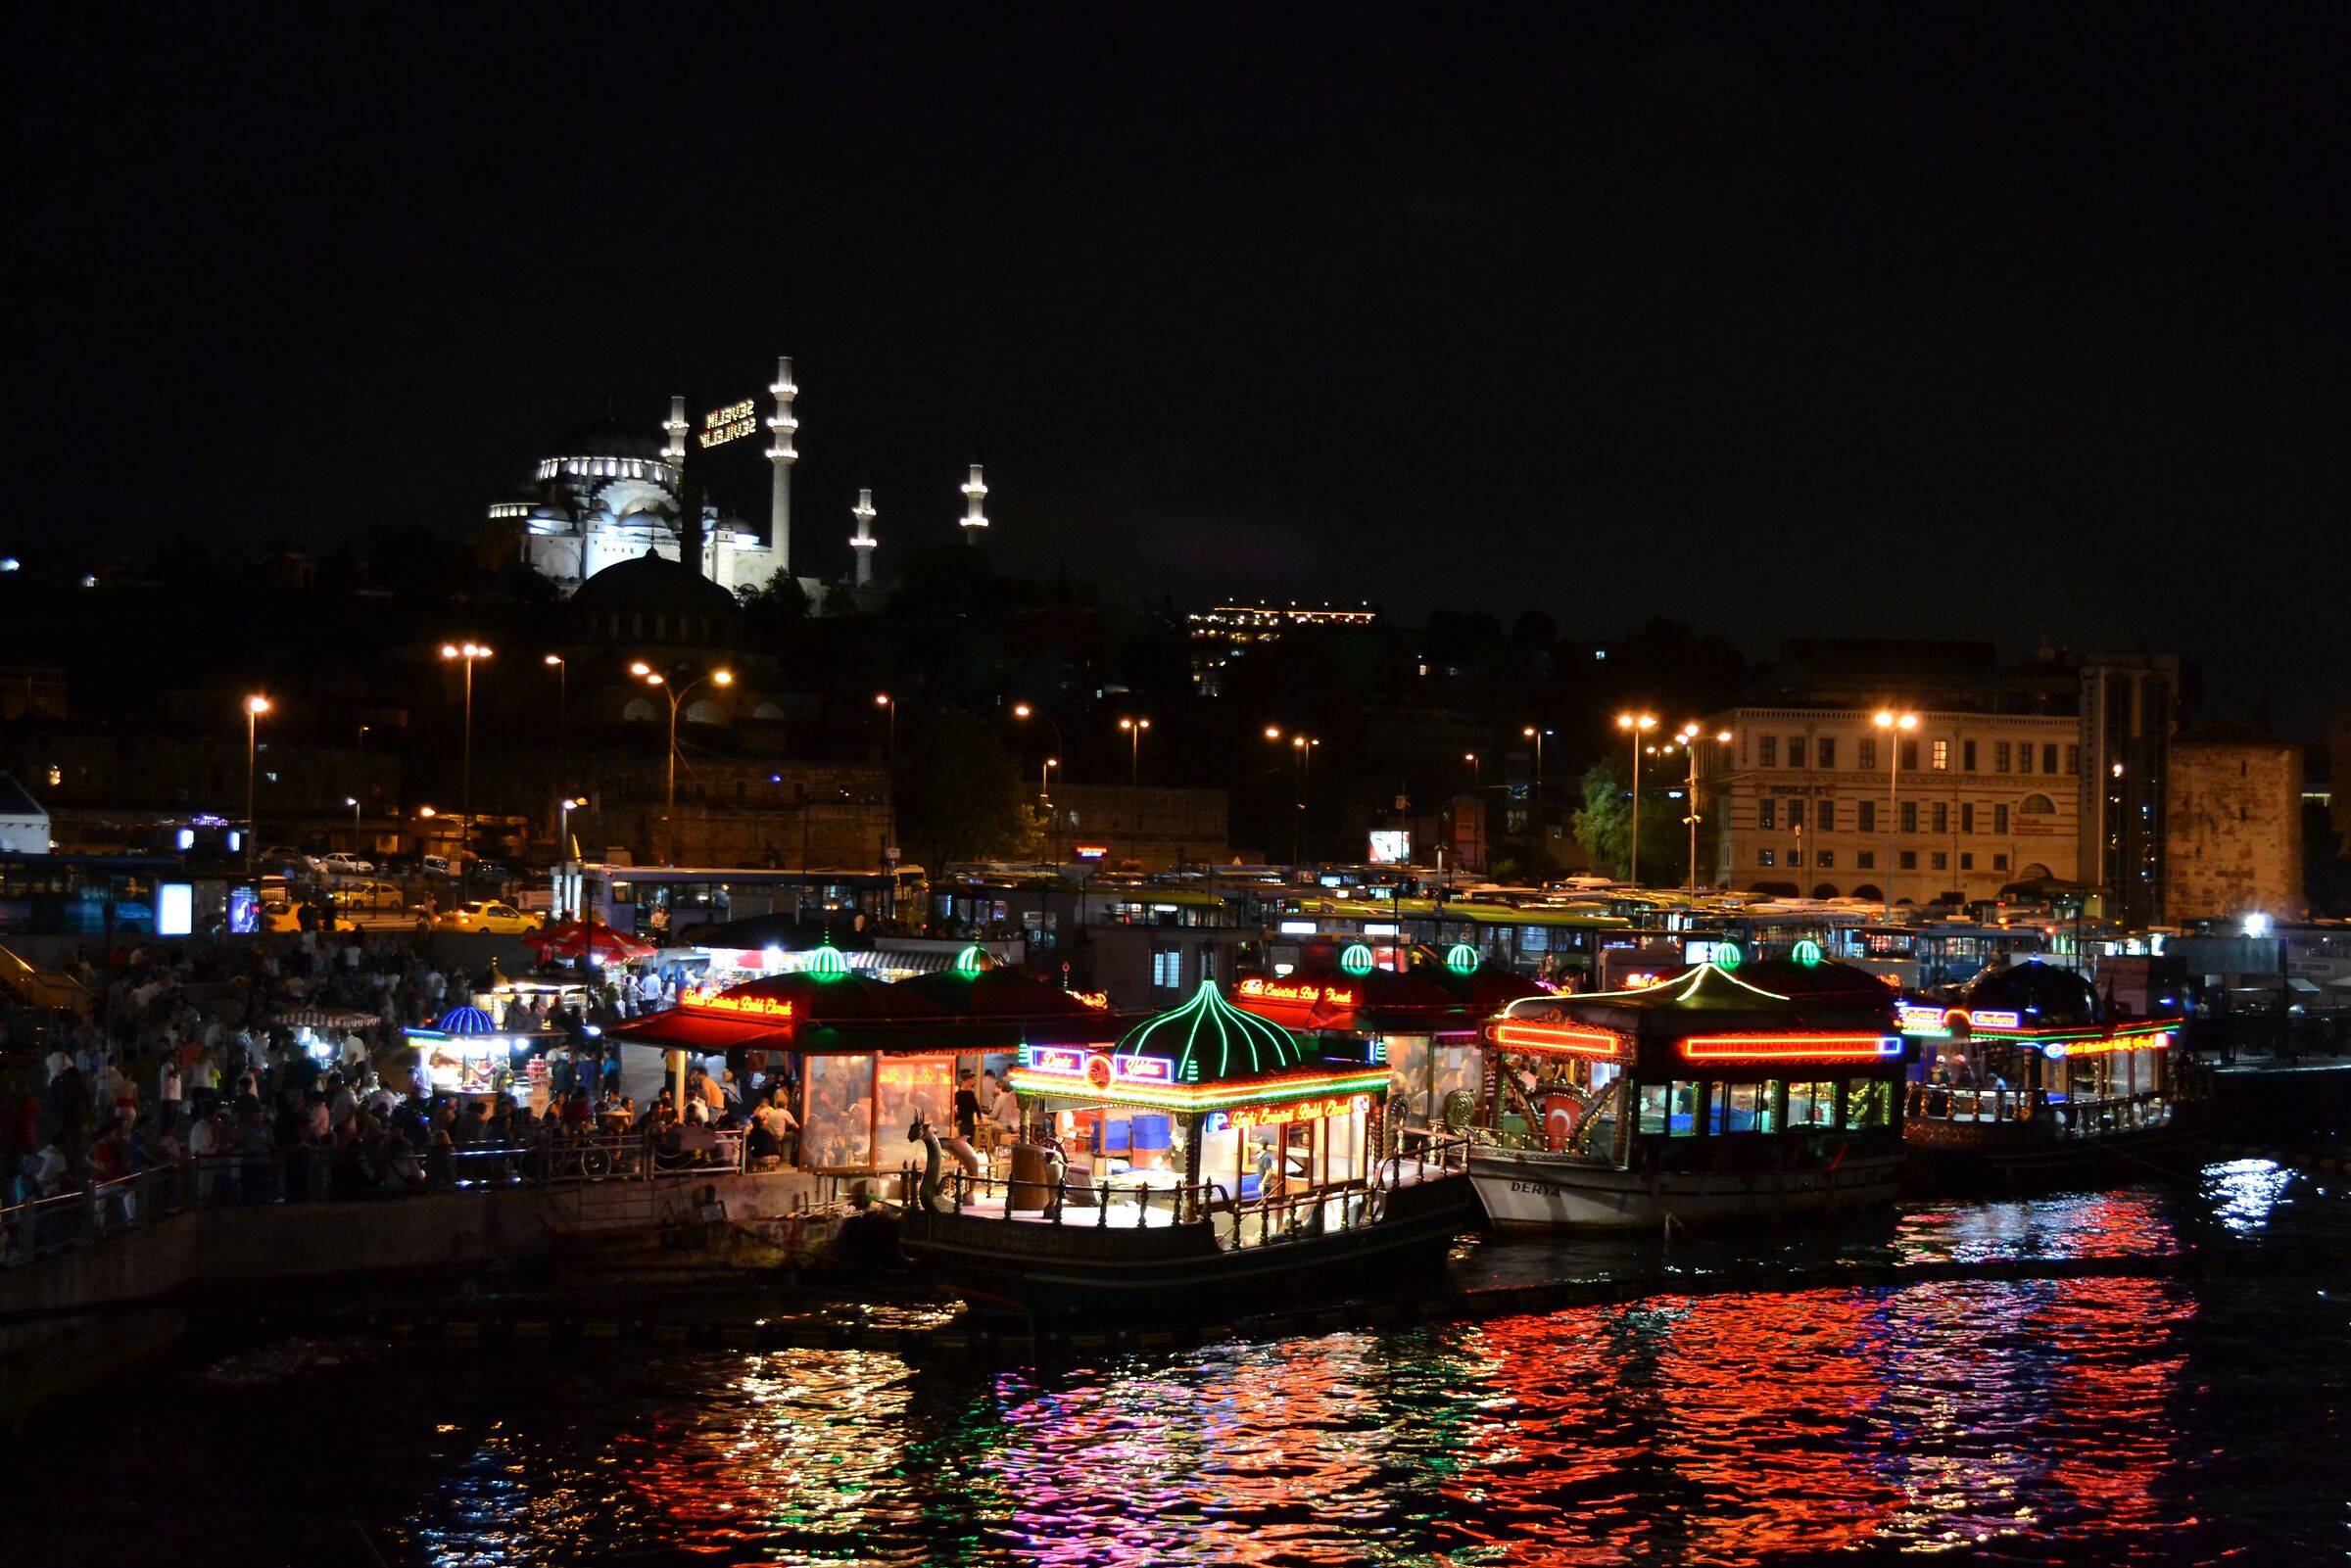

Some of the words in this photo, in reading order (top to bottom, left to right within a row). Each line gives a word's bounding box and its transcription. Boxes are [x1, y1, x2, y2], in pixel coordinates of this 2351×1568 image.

[1297, 1103, 1322, 1120] Balık
[1325, 1100, 1351, 1117] Ekmek
[1511, 1181, 1560, 1198] DERYA
